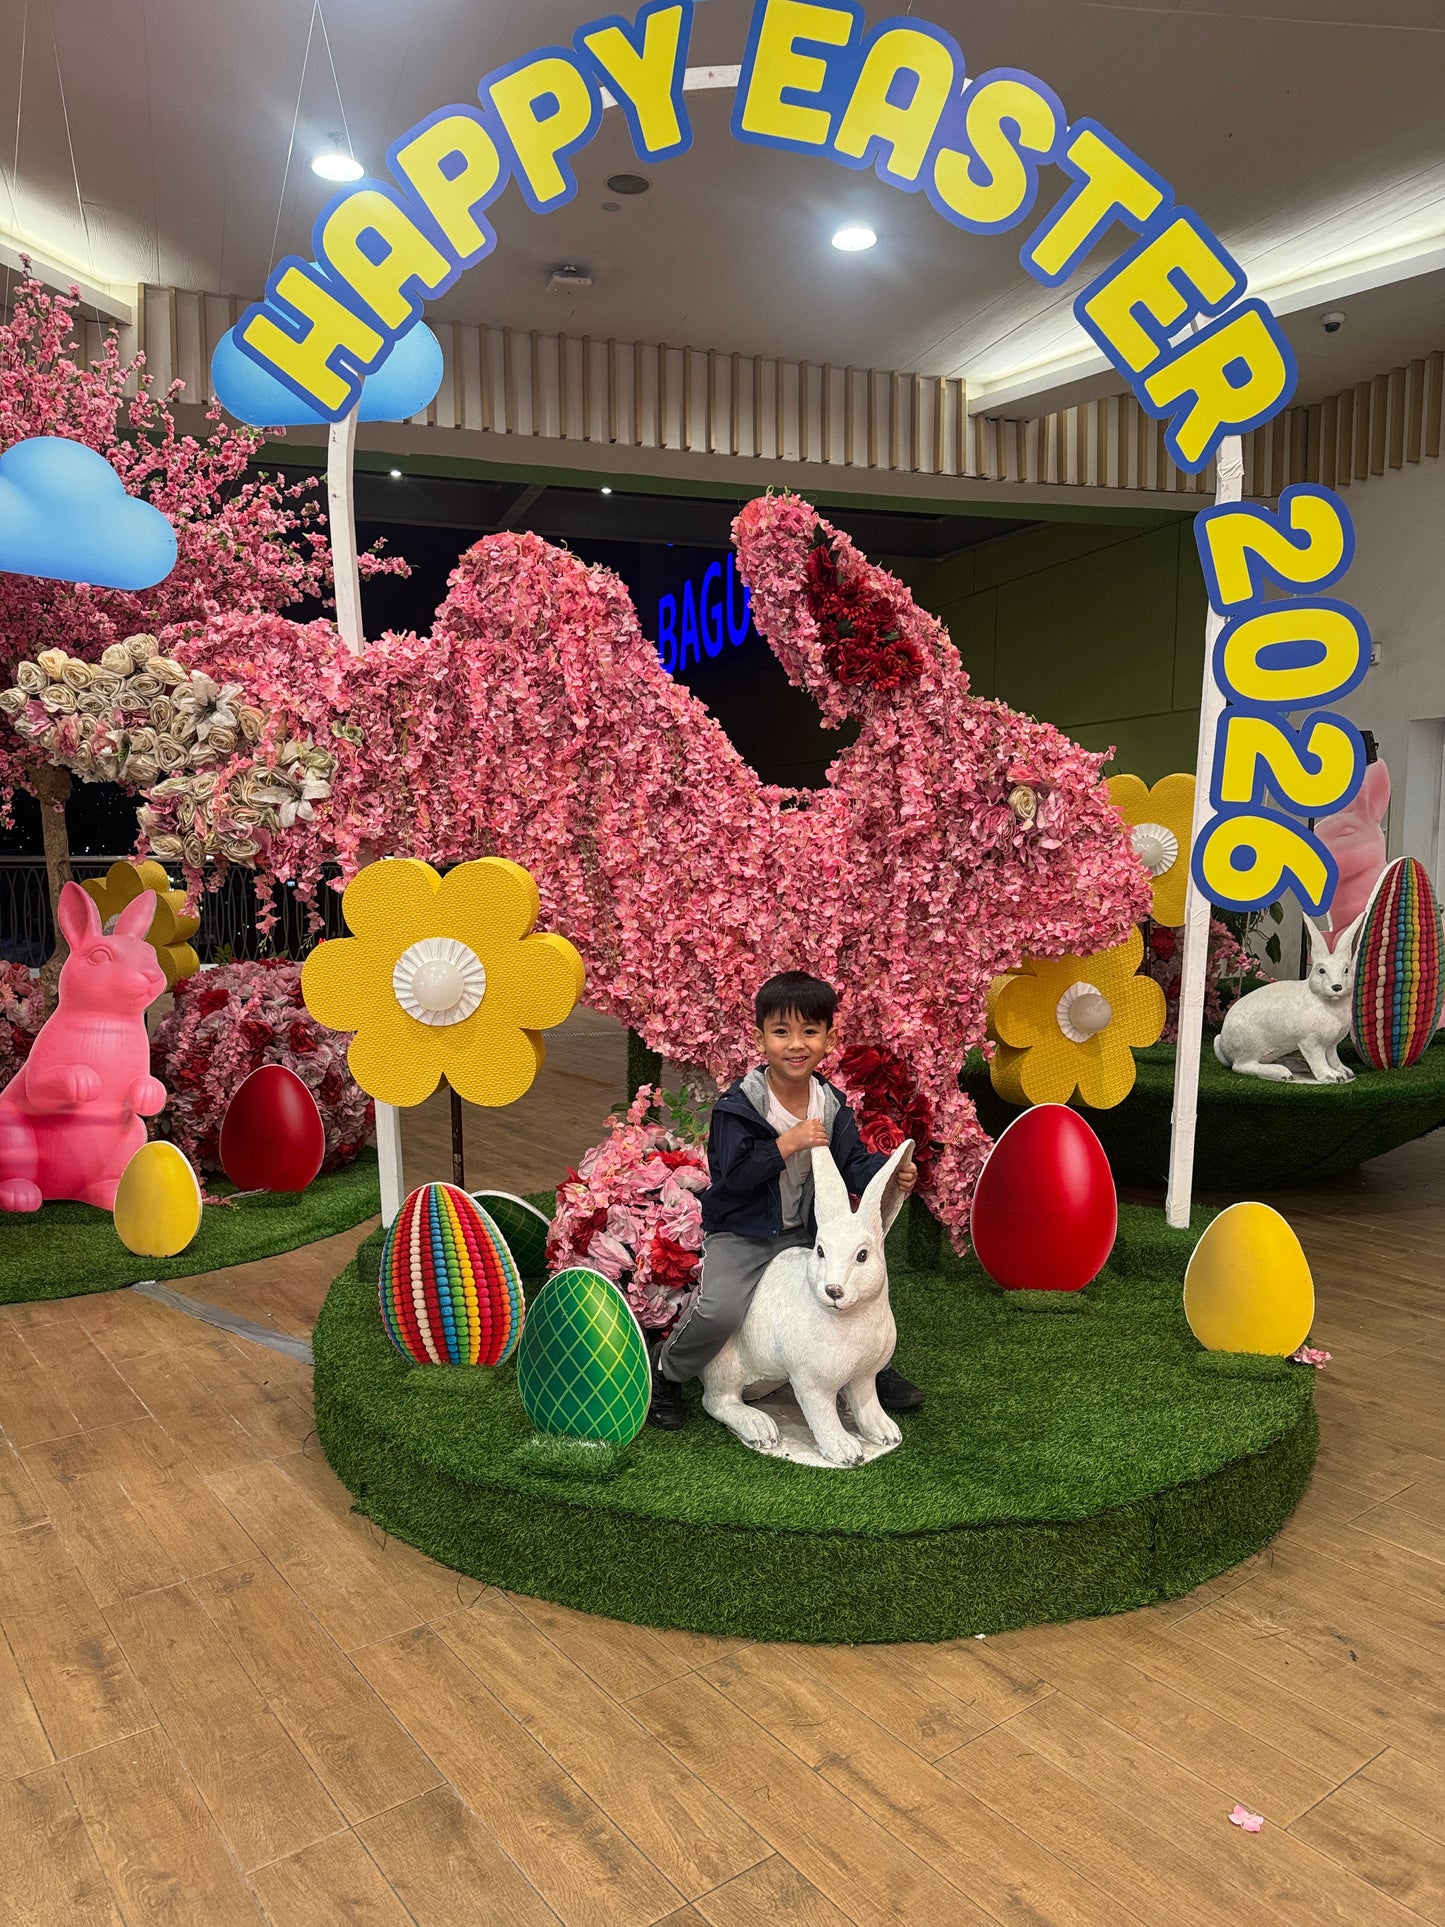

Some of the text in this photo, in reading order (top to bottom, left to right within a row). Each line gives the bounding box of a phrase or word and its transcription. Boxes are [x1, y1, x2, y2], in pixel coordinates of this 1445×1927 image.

[241, 0, 1361, 908] HAPPY EASTER 2026
[658, 551, 761, 675] BAGU
